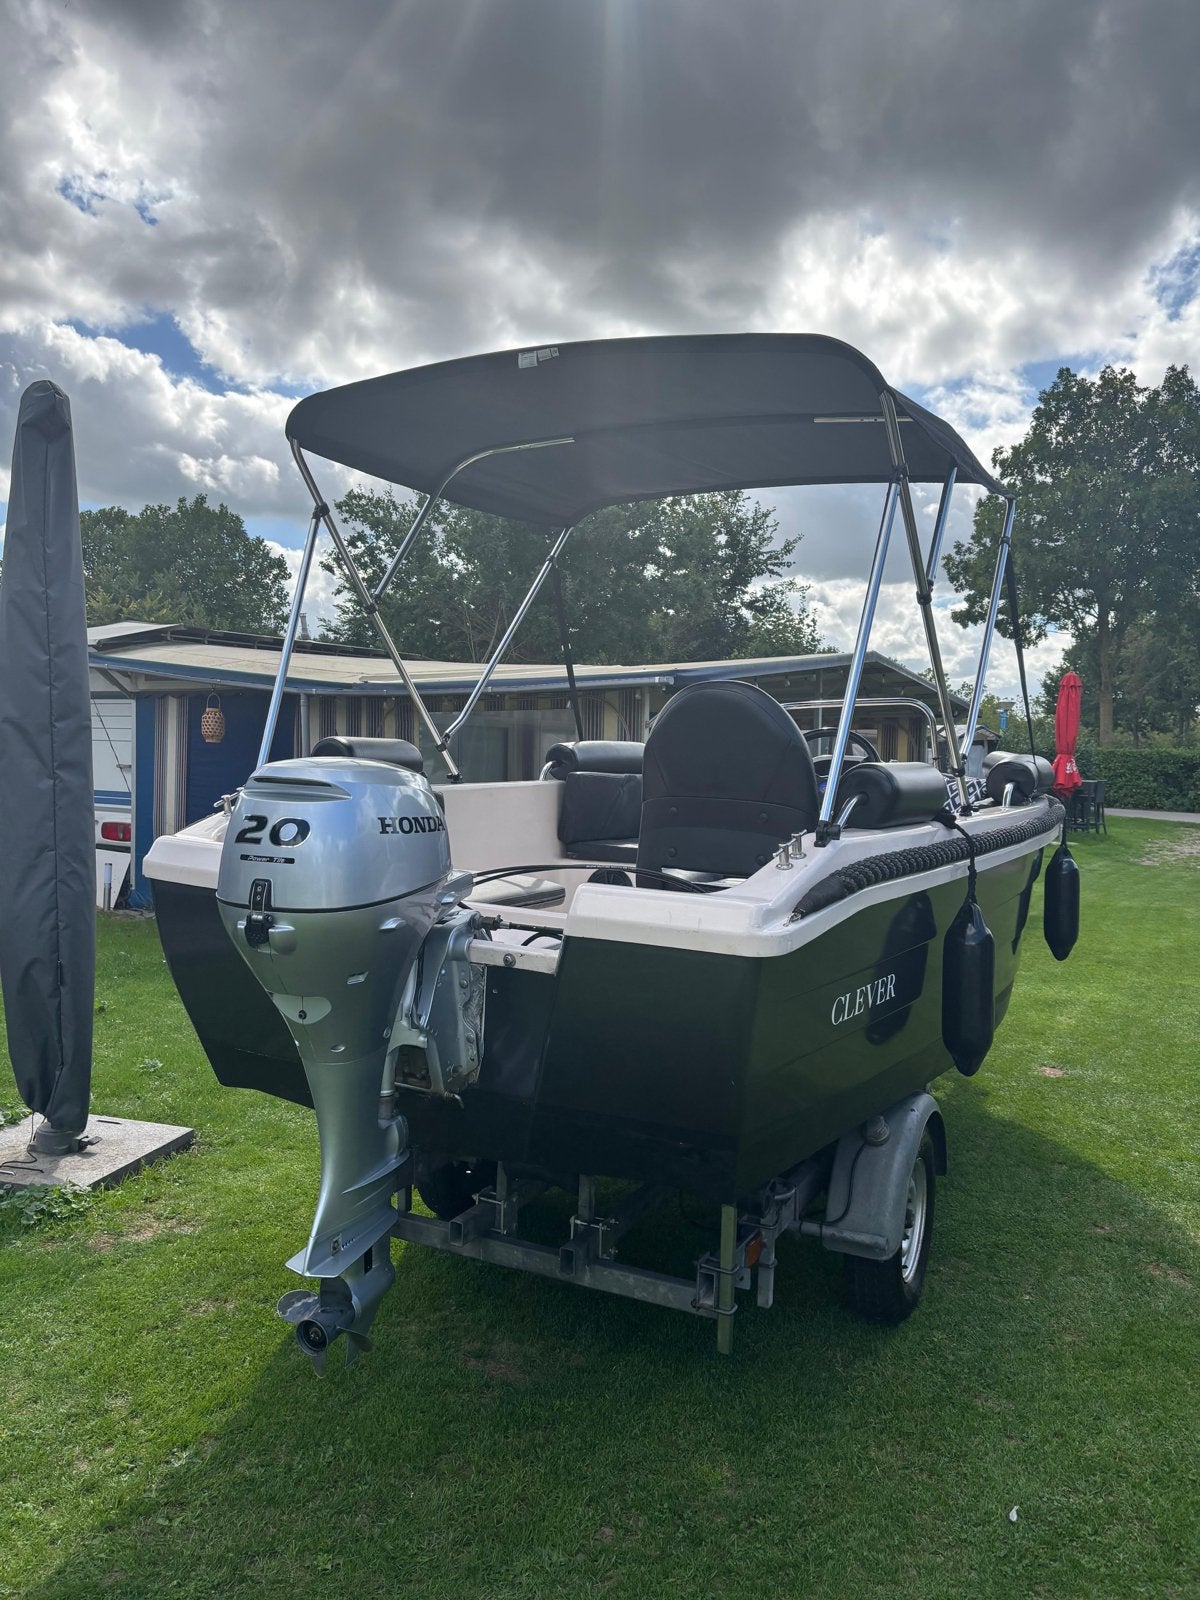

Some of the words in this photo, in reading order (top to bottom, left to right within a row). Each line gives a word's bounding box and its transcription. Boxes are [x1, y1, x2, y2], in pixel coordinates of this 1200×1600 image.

[234, 814, 312, 848] 20
[377, 815, 446, 835] HONDA
[247, 855, 270, 863] Power
[831, 973, 896, 1026] CLEVER
